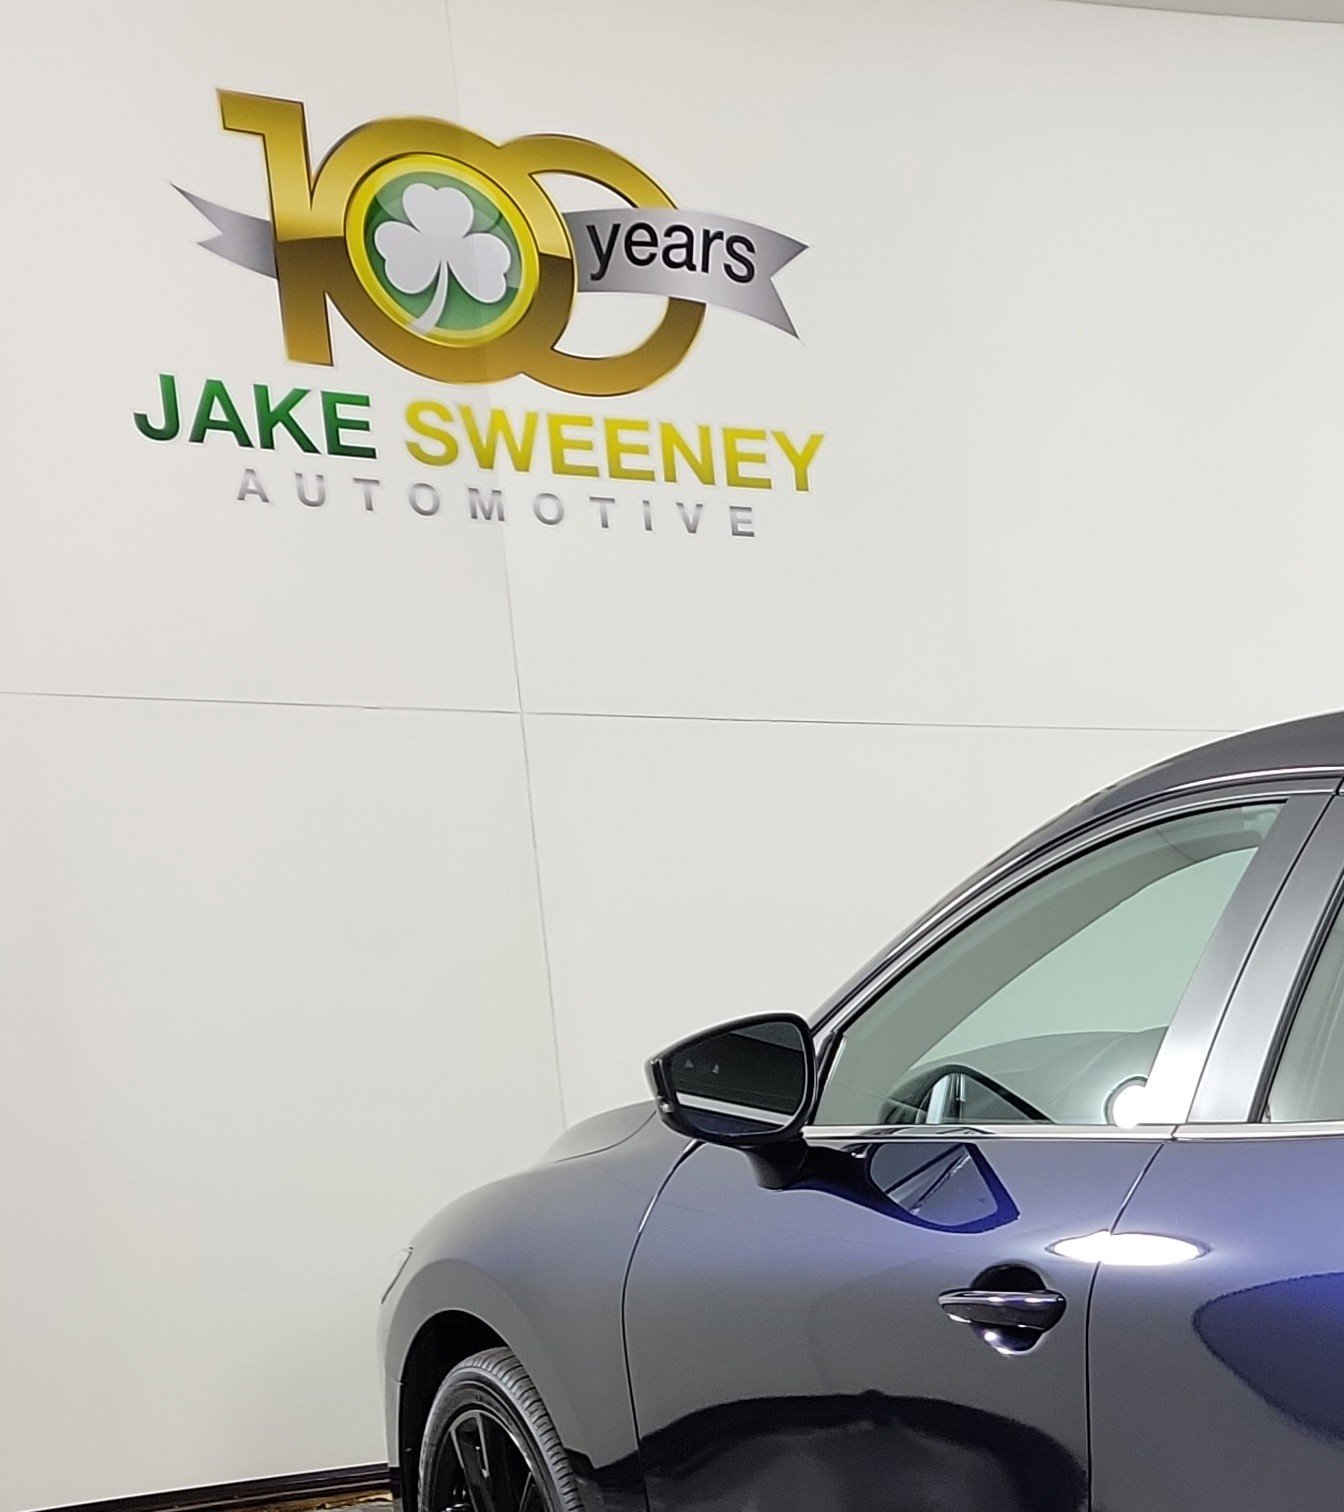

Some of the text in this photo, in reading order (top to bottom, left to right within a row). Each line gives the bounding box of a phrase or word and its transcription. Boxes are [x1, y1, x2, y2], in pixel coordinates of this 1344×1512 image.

[586, 217, 757, 284] years
[133, 373, 825, 493] JAKE SWEENEY
[237, 467, 755, 538] AUTOMOTIVE
